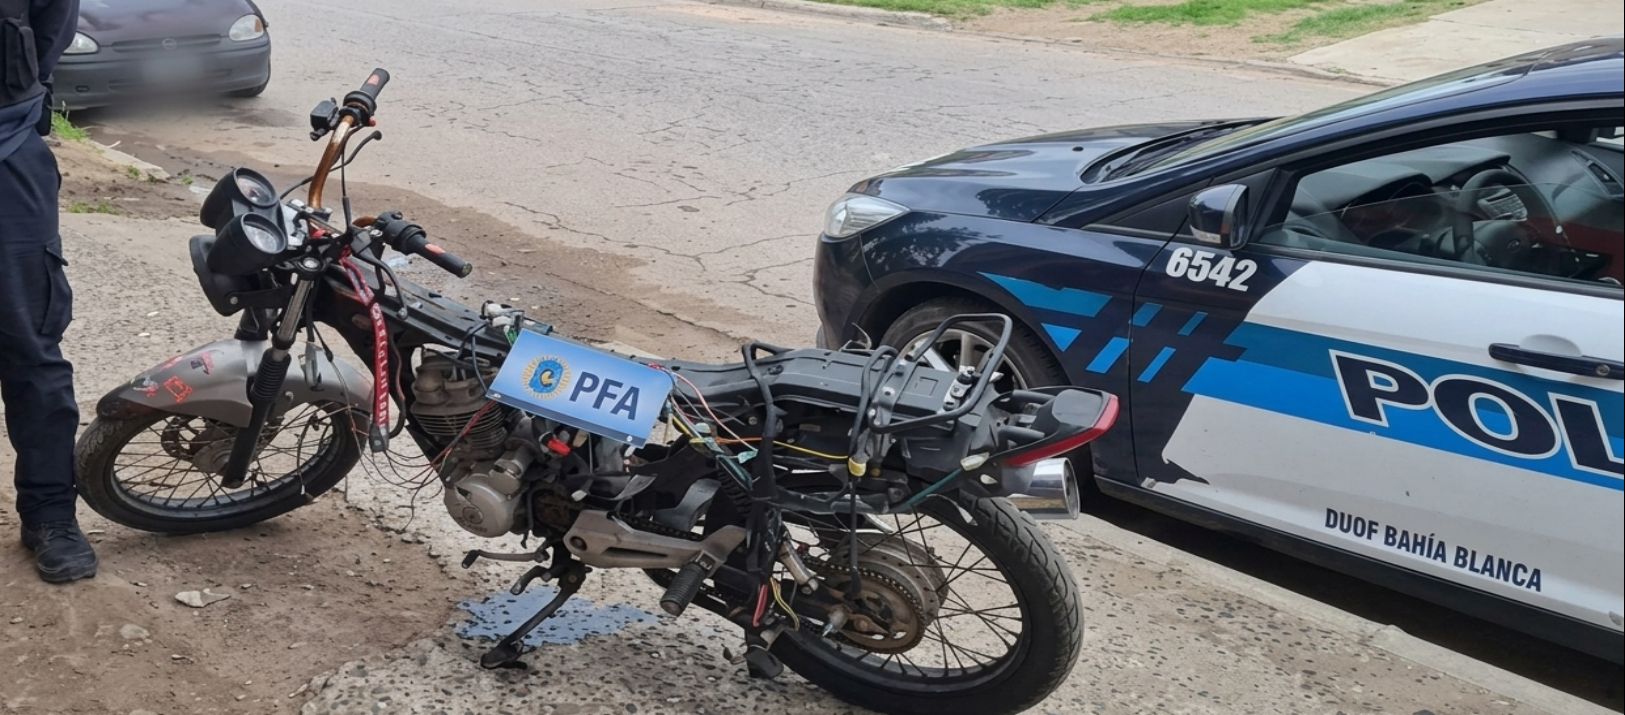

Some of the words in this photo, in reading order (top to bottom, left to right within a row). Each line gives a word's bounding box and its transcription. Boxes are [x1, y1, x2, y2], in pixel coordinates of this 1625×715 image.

[1166, 247, 1257, 291] 6542
[569, 371, 640, 420] PFA
[1328, 348, 1623, 479] POL
[1325, 508, 1379, 540] DUOF
[1384, 524, 1447, 563] BAHÍA
[1453, 545, 1541, 592] BLANCA
